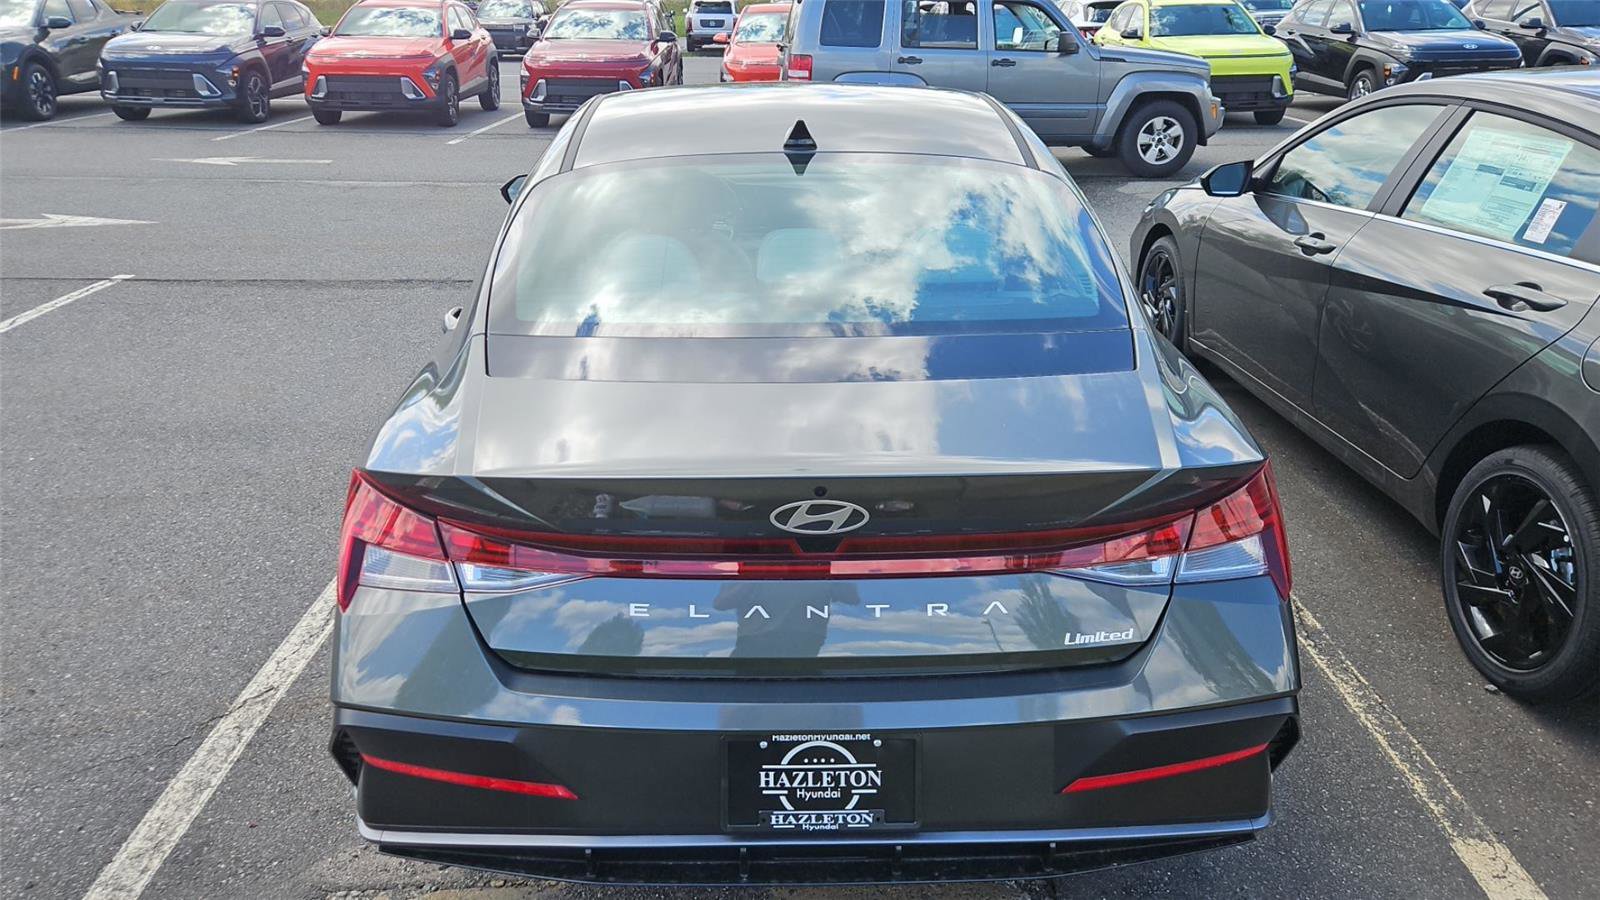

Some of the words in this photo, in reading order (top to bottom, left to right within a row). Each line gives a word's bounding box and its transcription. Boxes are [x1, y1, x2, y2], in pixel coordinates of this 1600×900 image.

[629, 601, 1008, 618] ELANTRA
[1064, 628, 1134, 645] Limited
[759, 770, 882, 788] HAZLETON
[796, 788, 841, 801] Hyundai
[770, 813, 874, 825] HAZLETON
[802, 823, 839, 831] Hyundai
